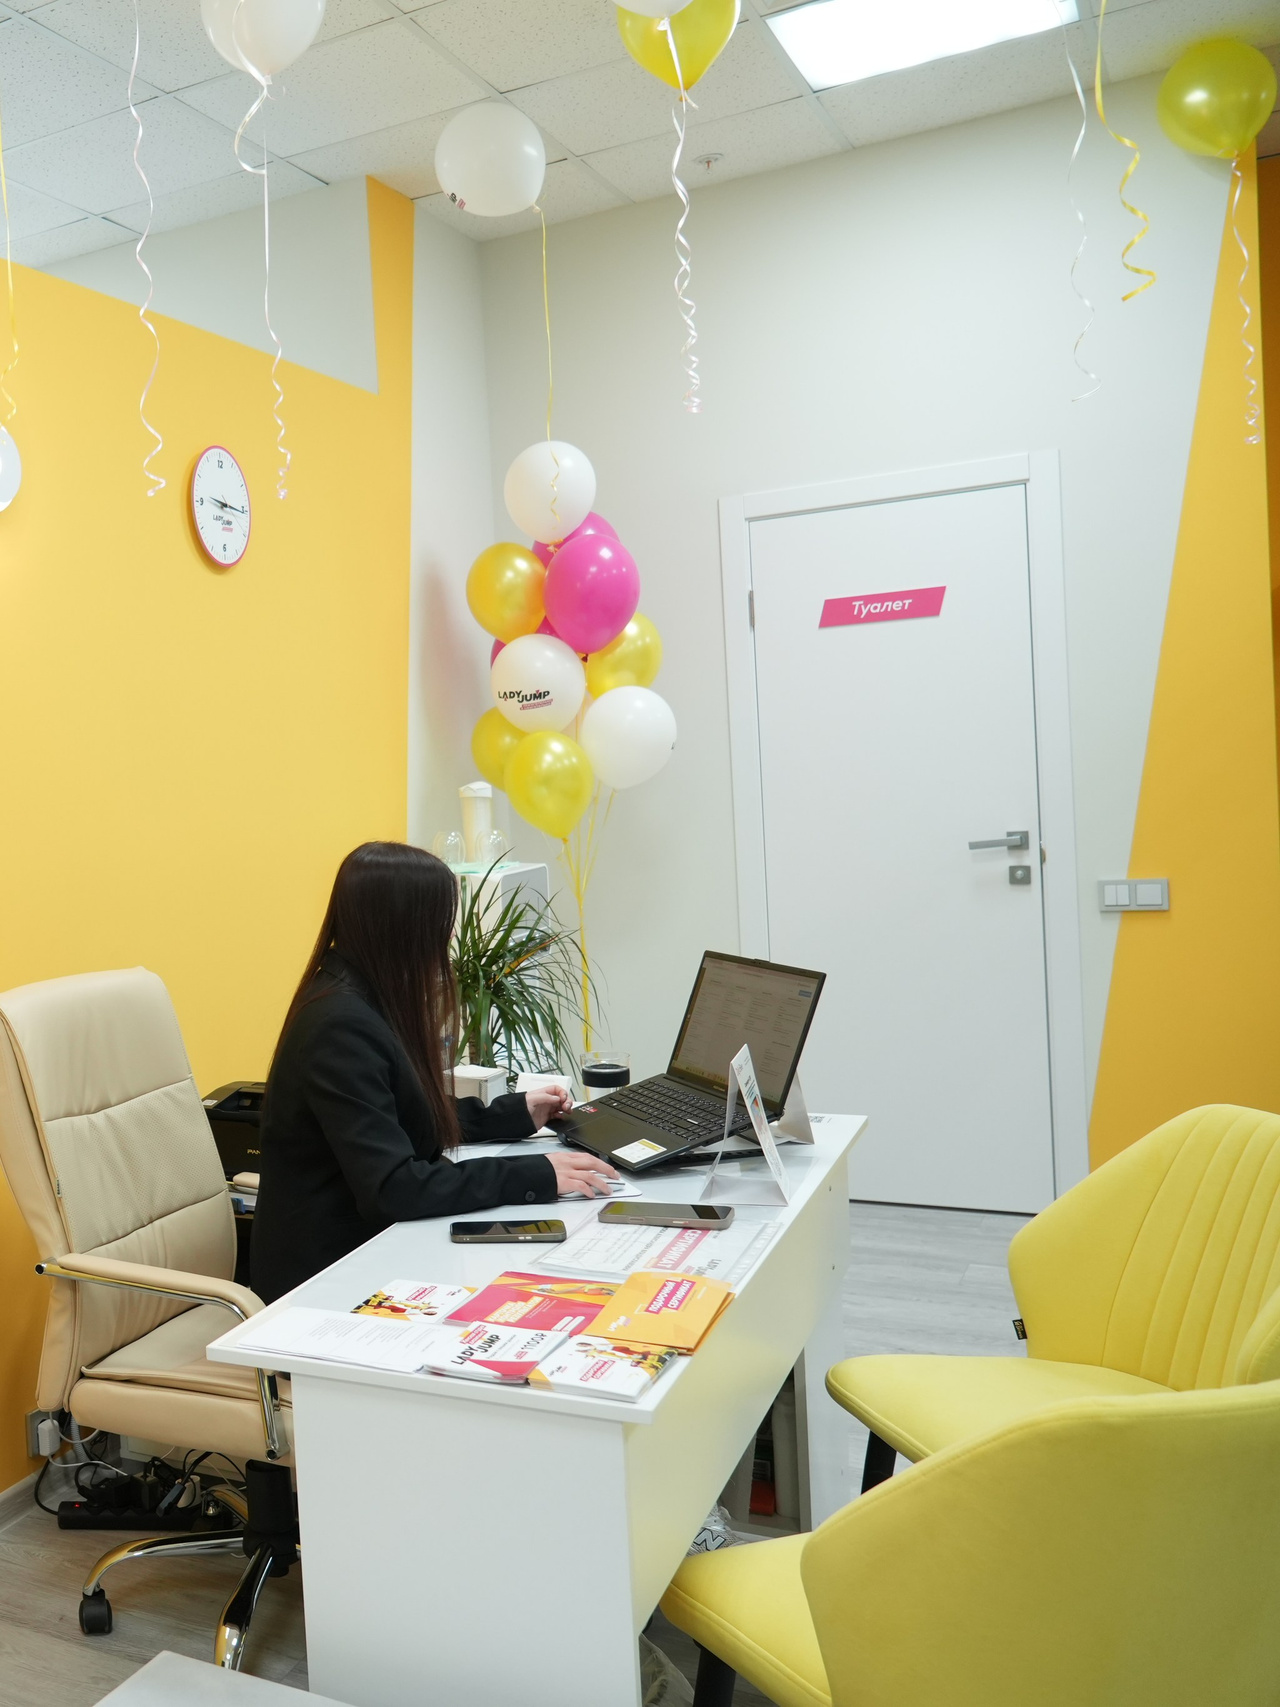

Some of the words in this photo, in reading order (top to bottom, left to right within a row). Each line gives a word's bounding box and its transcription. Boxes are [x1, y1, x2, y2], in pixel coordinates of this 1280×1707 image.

[217, 459, 224, 469] 12
[199, 497, 204, 506] 9
[222, 543, 227, 552] 6
[852, 599, 913, 618] Туалет
[498, 690, 522, 701] LADY
[517, 690, 550, 703] JUMP
[667, 1280, 693, 1309] СЕРТИФИКАТ
[451, 1345, 478, 1365] LADY
[477, 1334, 501, 1353] JUMP
